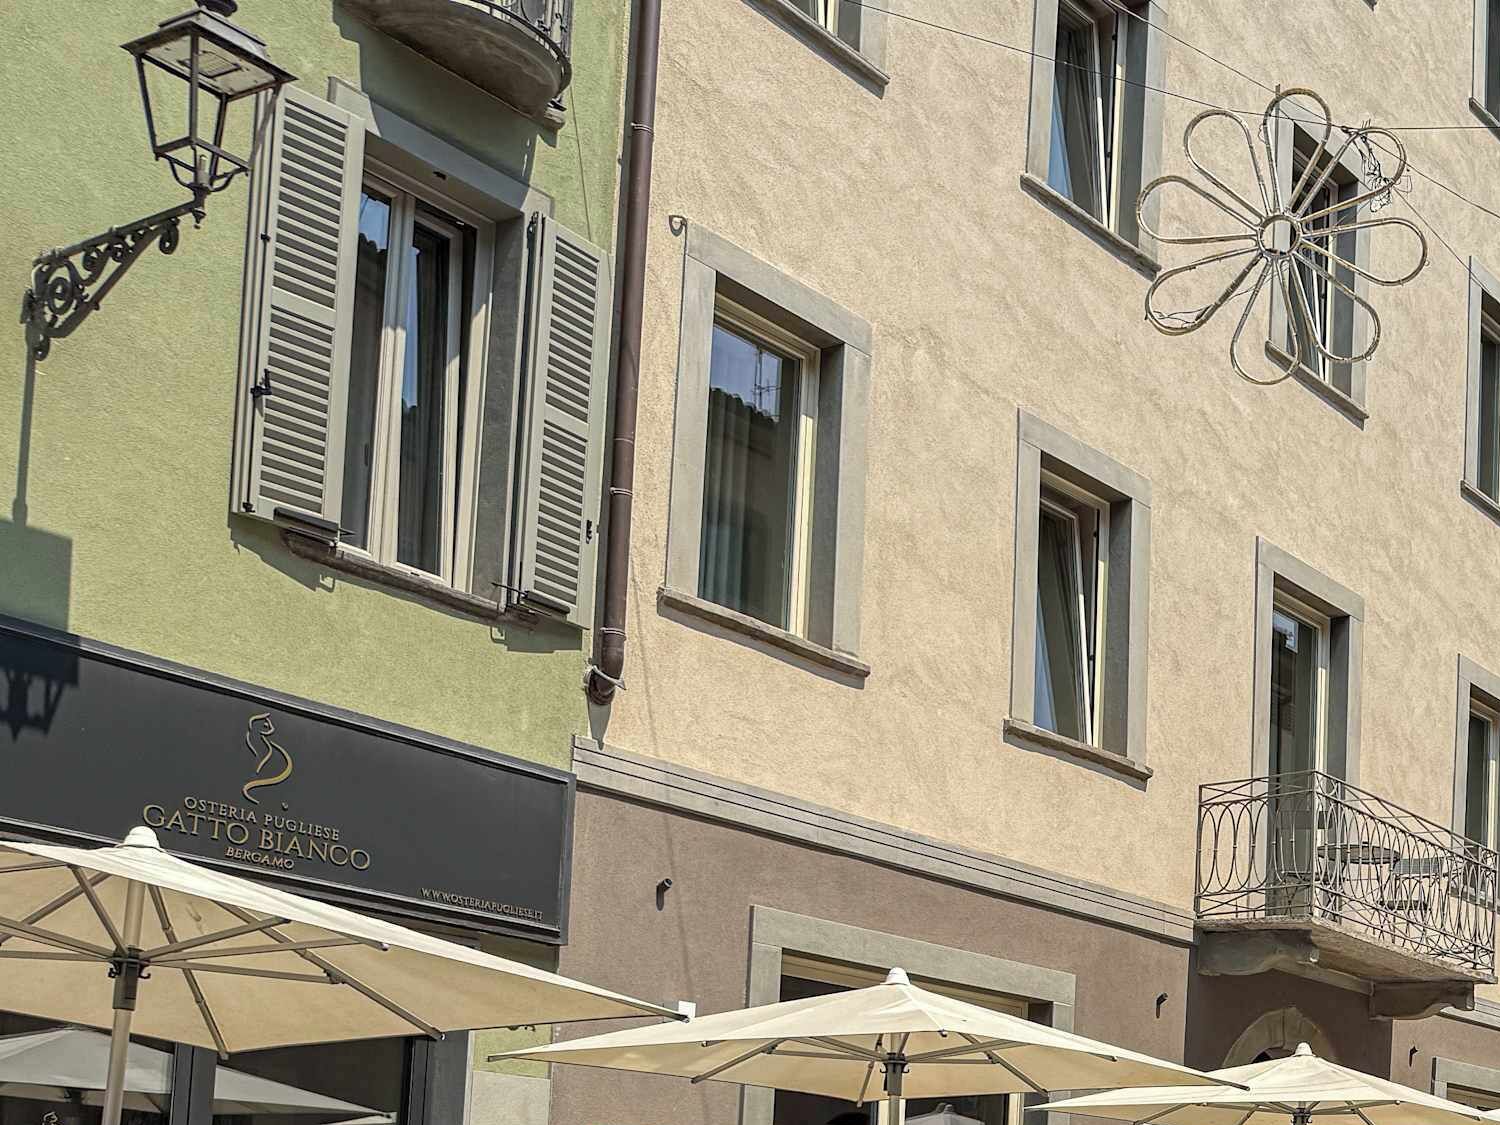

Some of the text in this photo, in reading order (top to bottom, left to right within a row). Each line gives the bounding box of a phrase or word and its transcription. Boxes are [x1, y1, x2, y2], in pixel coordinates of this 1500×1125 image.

[143, 804, 371, 870] GATTO BIANCO
[184, 796, 340, 842] OSTERIA PUGLIESE
[225, 847, 295, 870] BERGAMO
